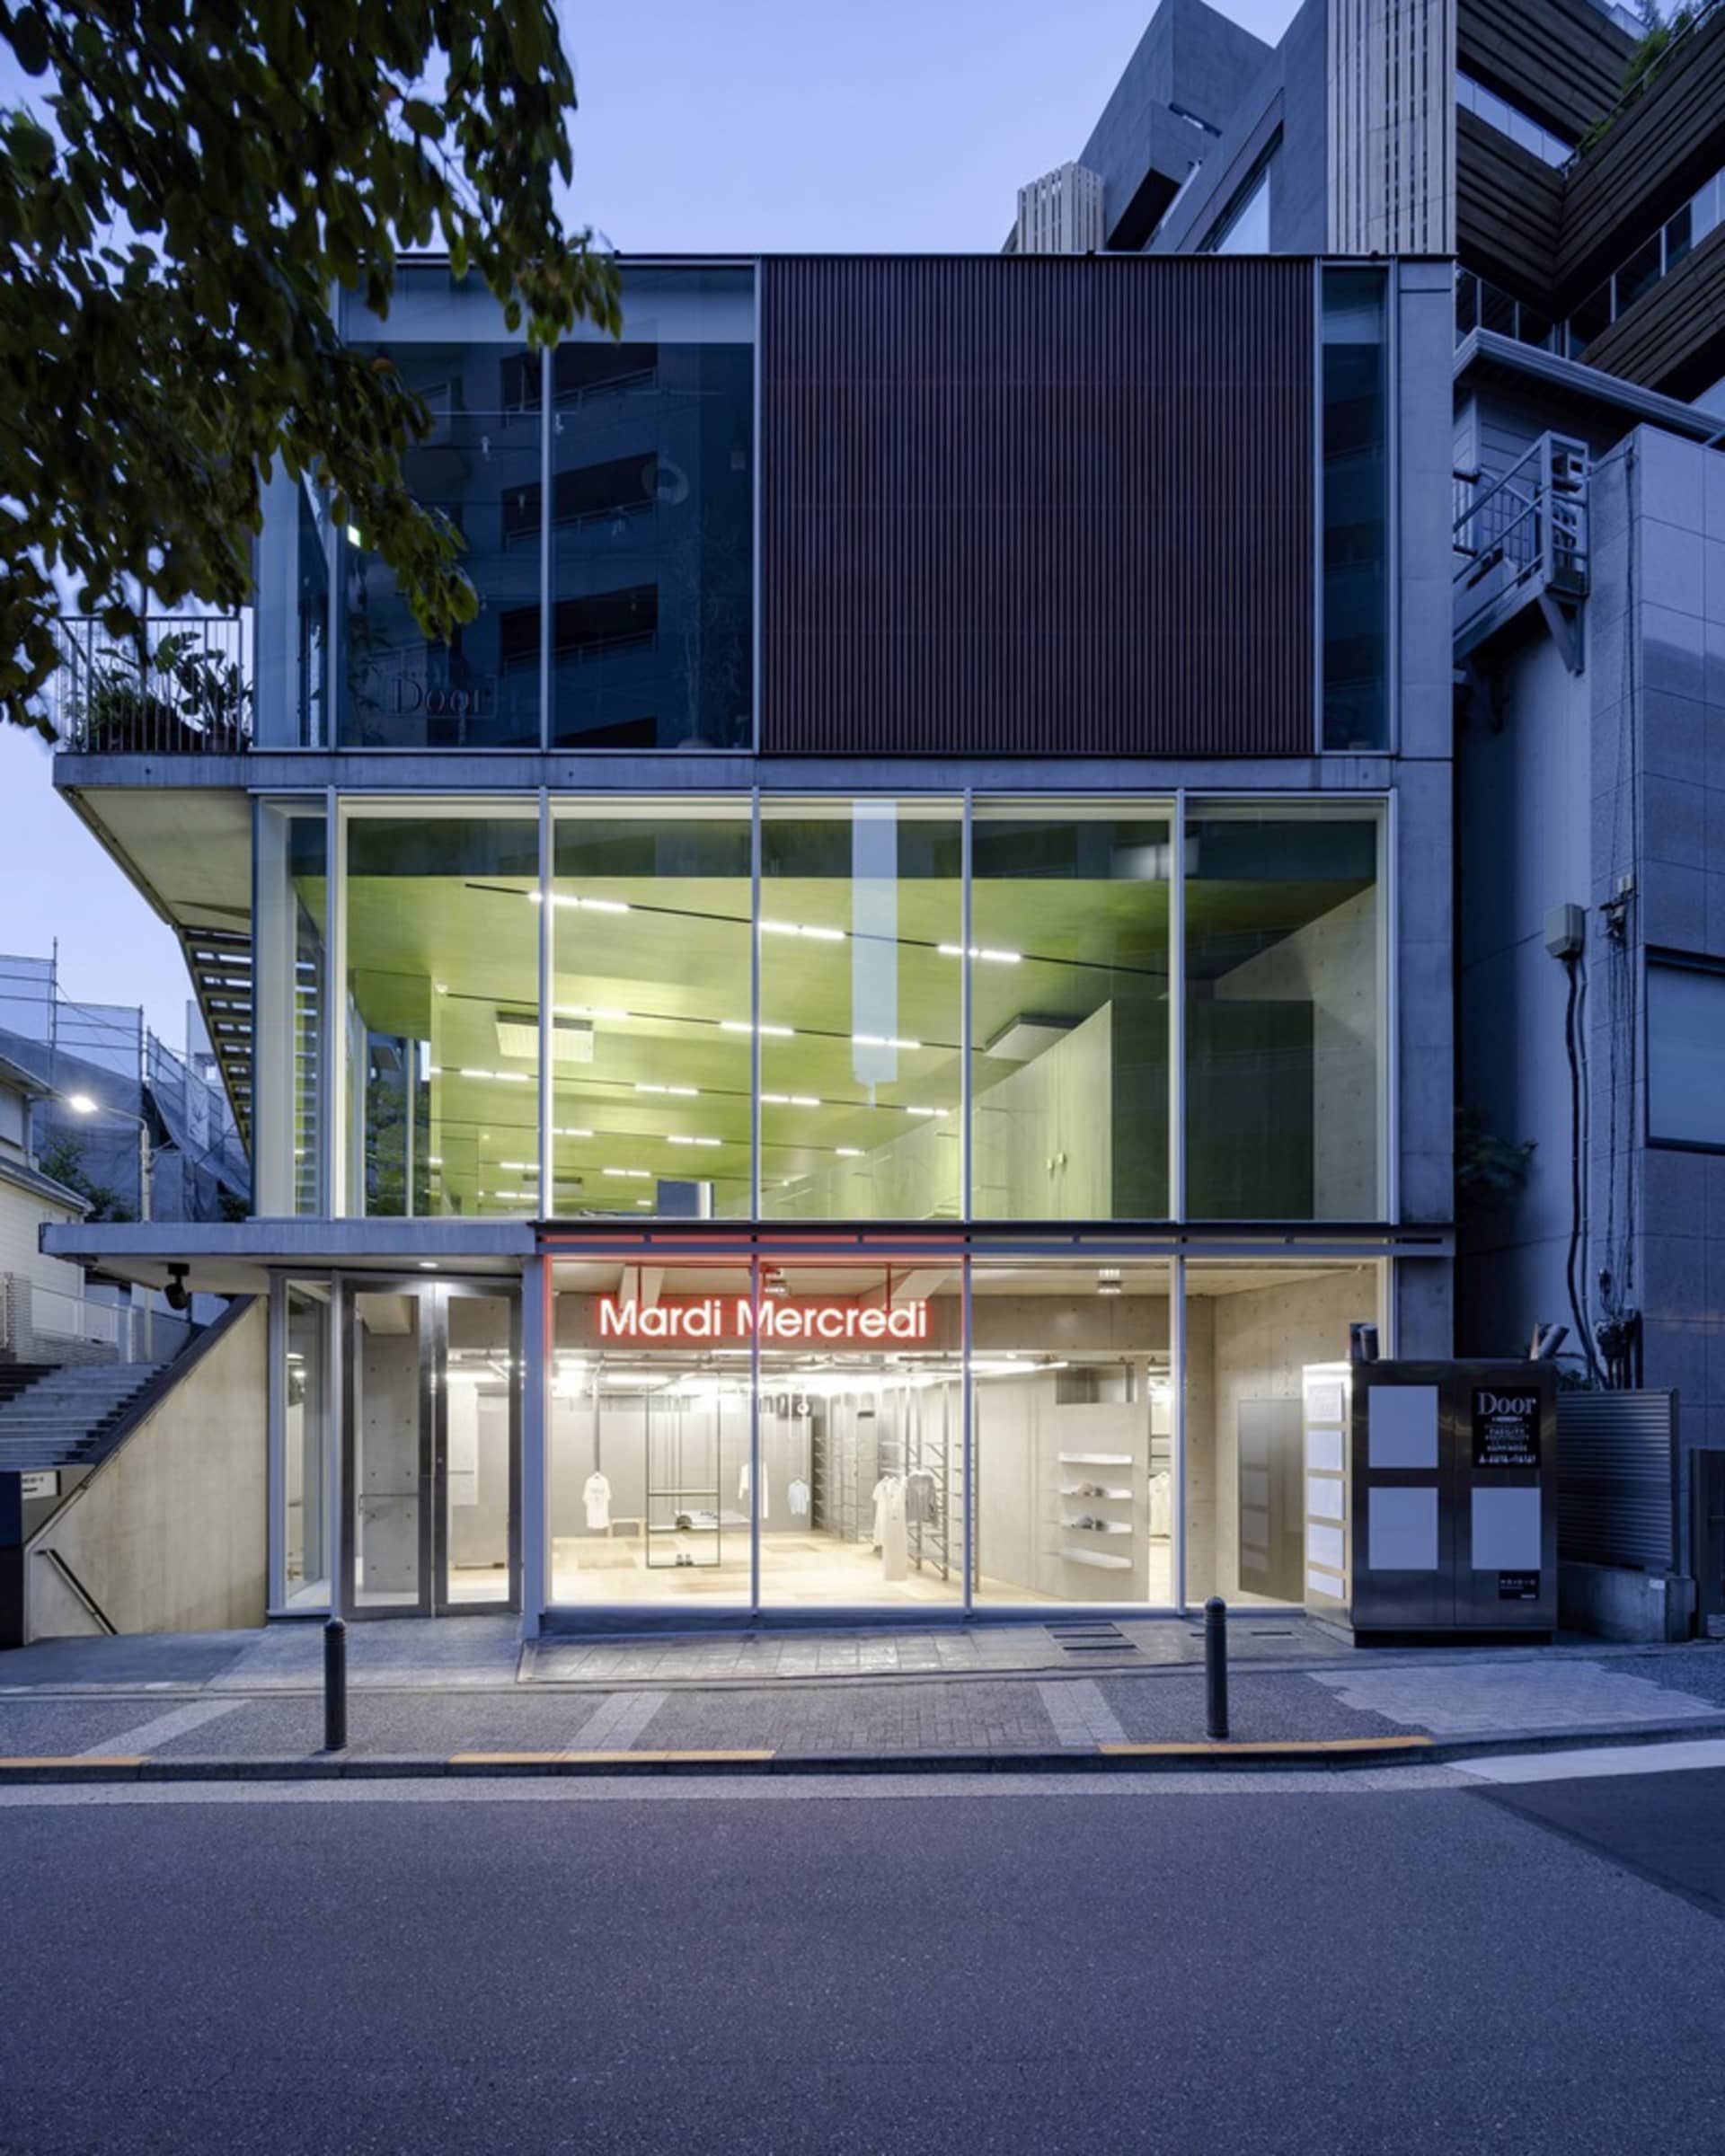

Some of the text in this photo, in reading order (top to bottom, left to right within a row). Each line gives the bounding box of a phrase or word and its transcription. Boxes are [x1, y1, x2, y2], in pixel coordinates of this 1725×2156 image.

[392, 677, 491, 714] Door
[599, 1299, 927, 1339] Mardi Mercredi
[1476, 1392, 1537, 1415] Door
